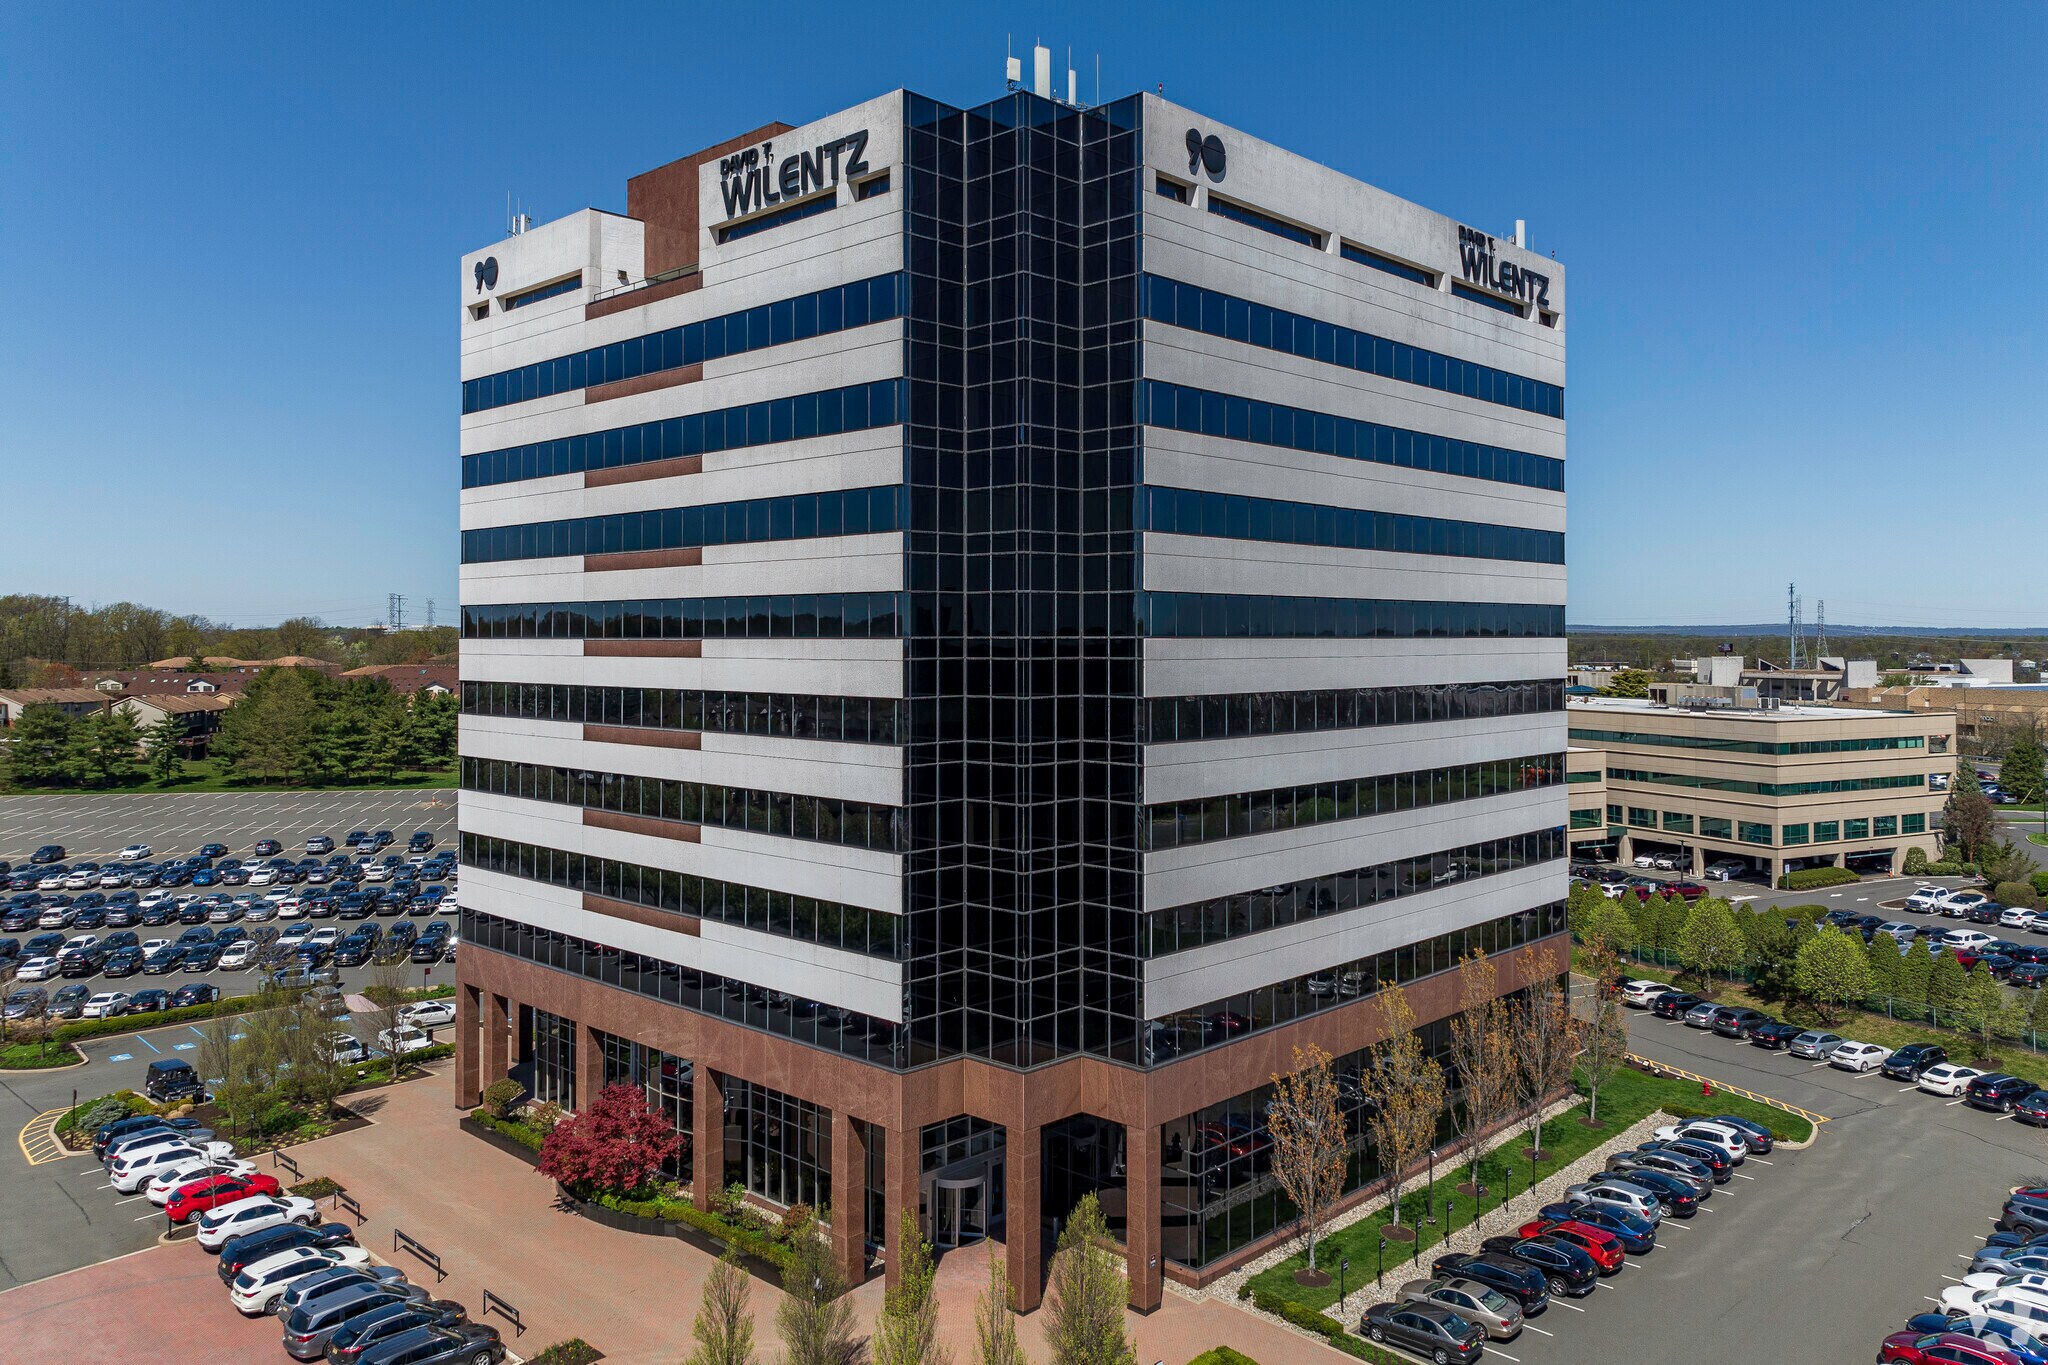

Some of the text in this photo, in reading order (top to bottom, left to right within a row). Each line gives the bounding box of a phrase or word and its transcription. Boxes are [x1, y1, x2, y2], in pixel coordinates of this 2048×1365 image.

[720, 148, 759, 177] DAVID
[1186, 128, 1226, 174] 90
[720, 129, 869, 215] WILENTZ
[1458, 225, 1486, 247] DAVID
[475, 256, 498, 290] 90
[1459, 244, 1549, 306] WILENTZ
